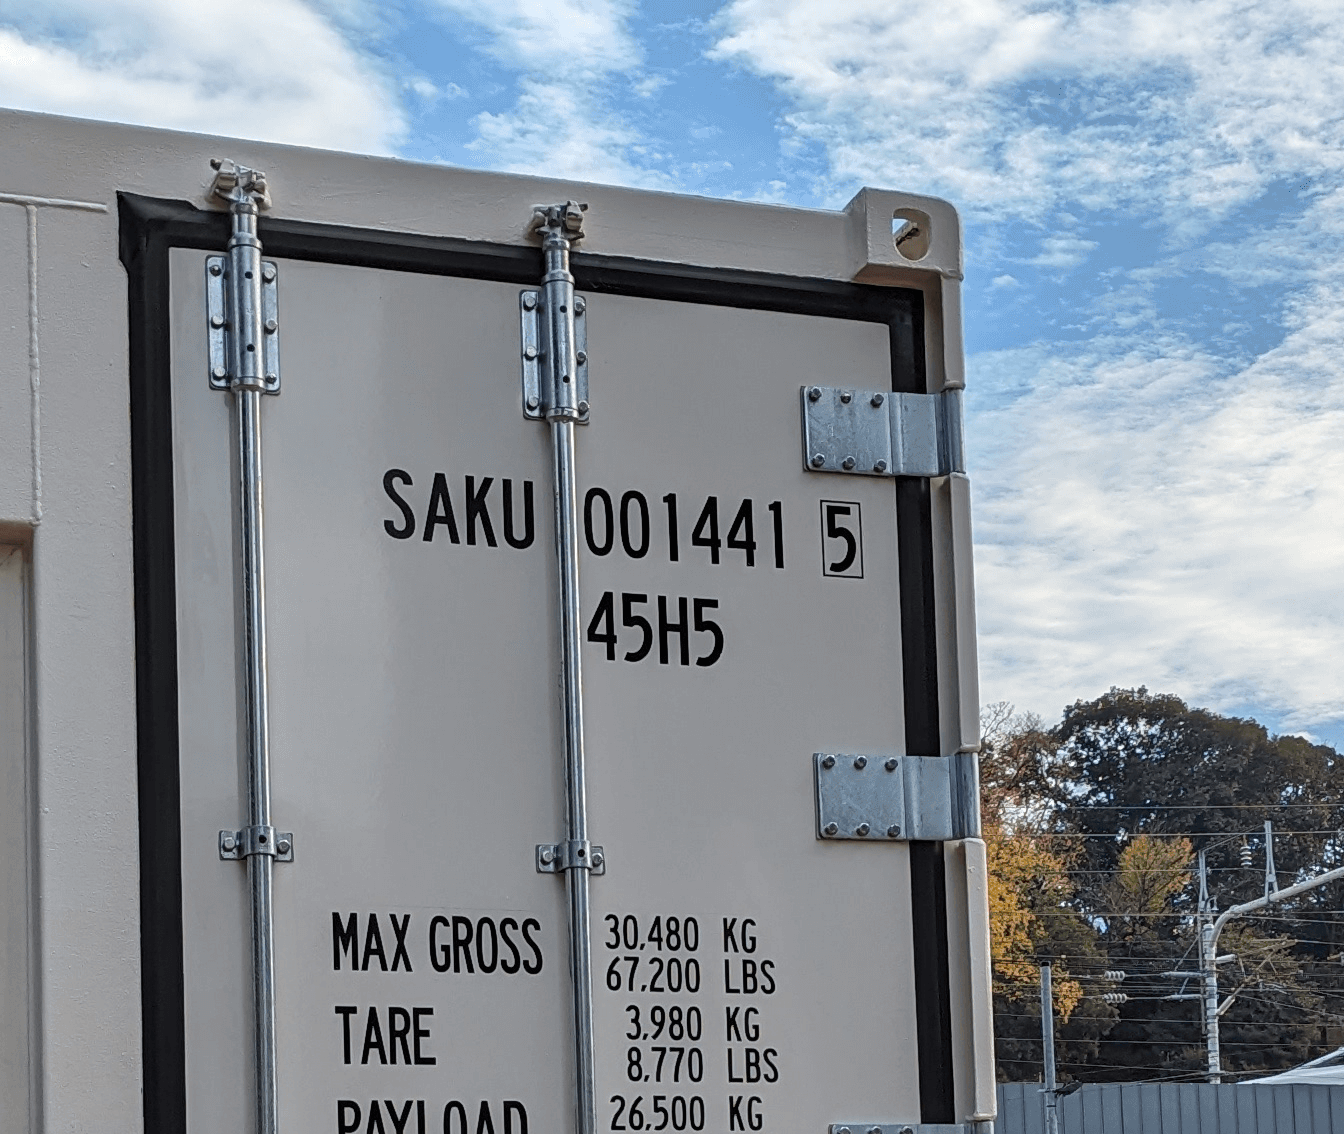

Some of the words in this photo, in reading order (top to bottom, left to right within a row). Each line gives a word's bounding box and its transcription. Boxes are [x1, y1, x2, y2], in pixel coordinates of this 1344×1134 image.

[383, 469, 534, 549] SAKU
[584, 488, 784, 568] 001441
[826, 504, 859, 572] 5
[587, 592, 723, 666] 45H5
[332, 912, 412, 972] MAX
[429, 916, 543, 974] GROSS
[605, 914, 698, 951] 30,480
[723, 918, 756, 953] KG
[607, 956, 700, 993] 67,200
[725, 959, 775, 994] LBS
[335, 1006, 436, 1065] TARE
[626, 1005, 701, 1041] 3,980
[726, 1007, 759, 1041] KG
[628, 1047, 703, 1082] 8,770
[728, 1048, 778, 1083] LBS
[610, 1095, 704, 1131] 26,500
[729, 1096, 762, 1131] KG
